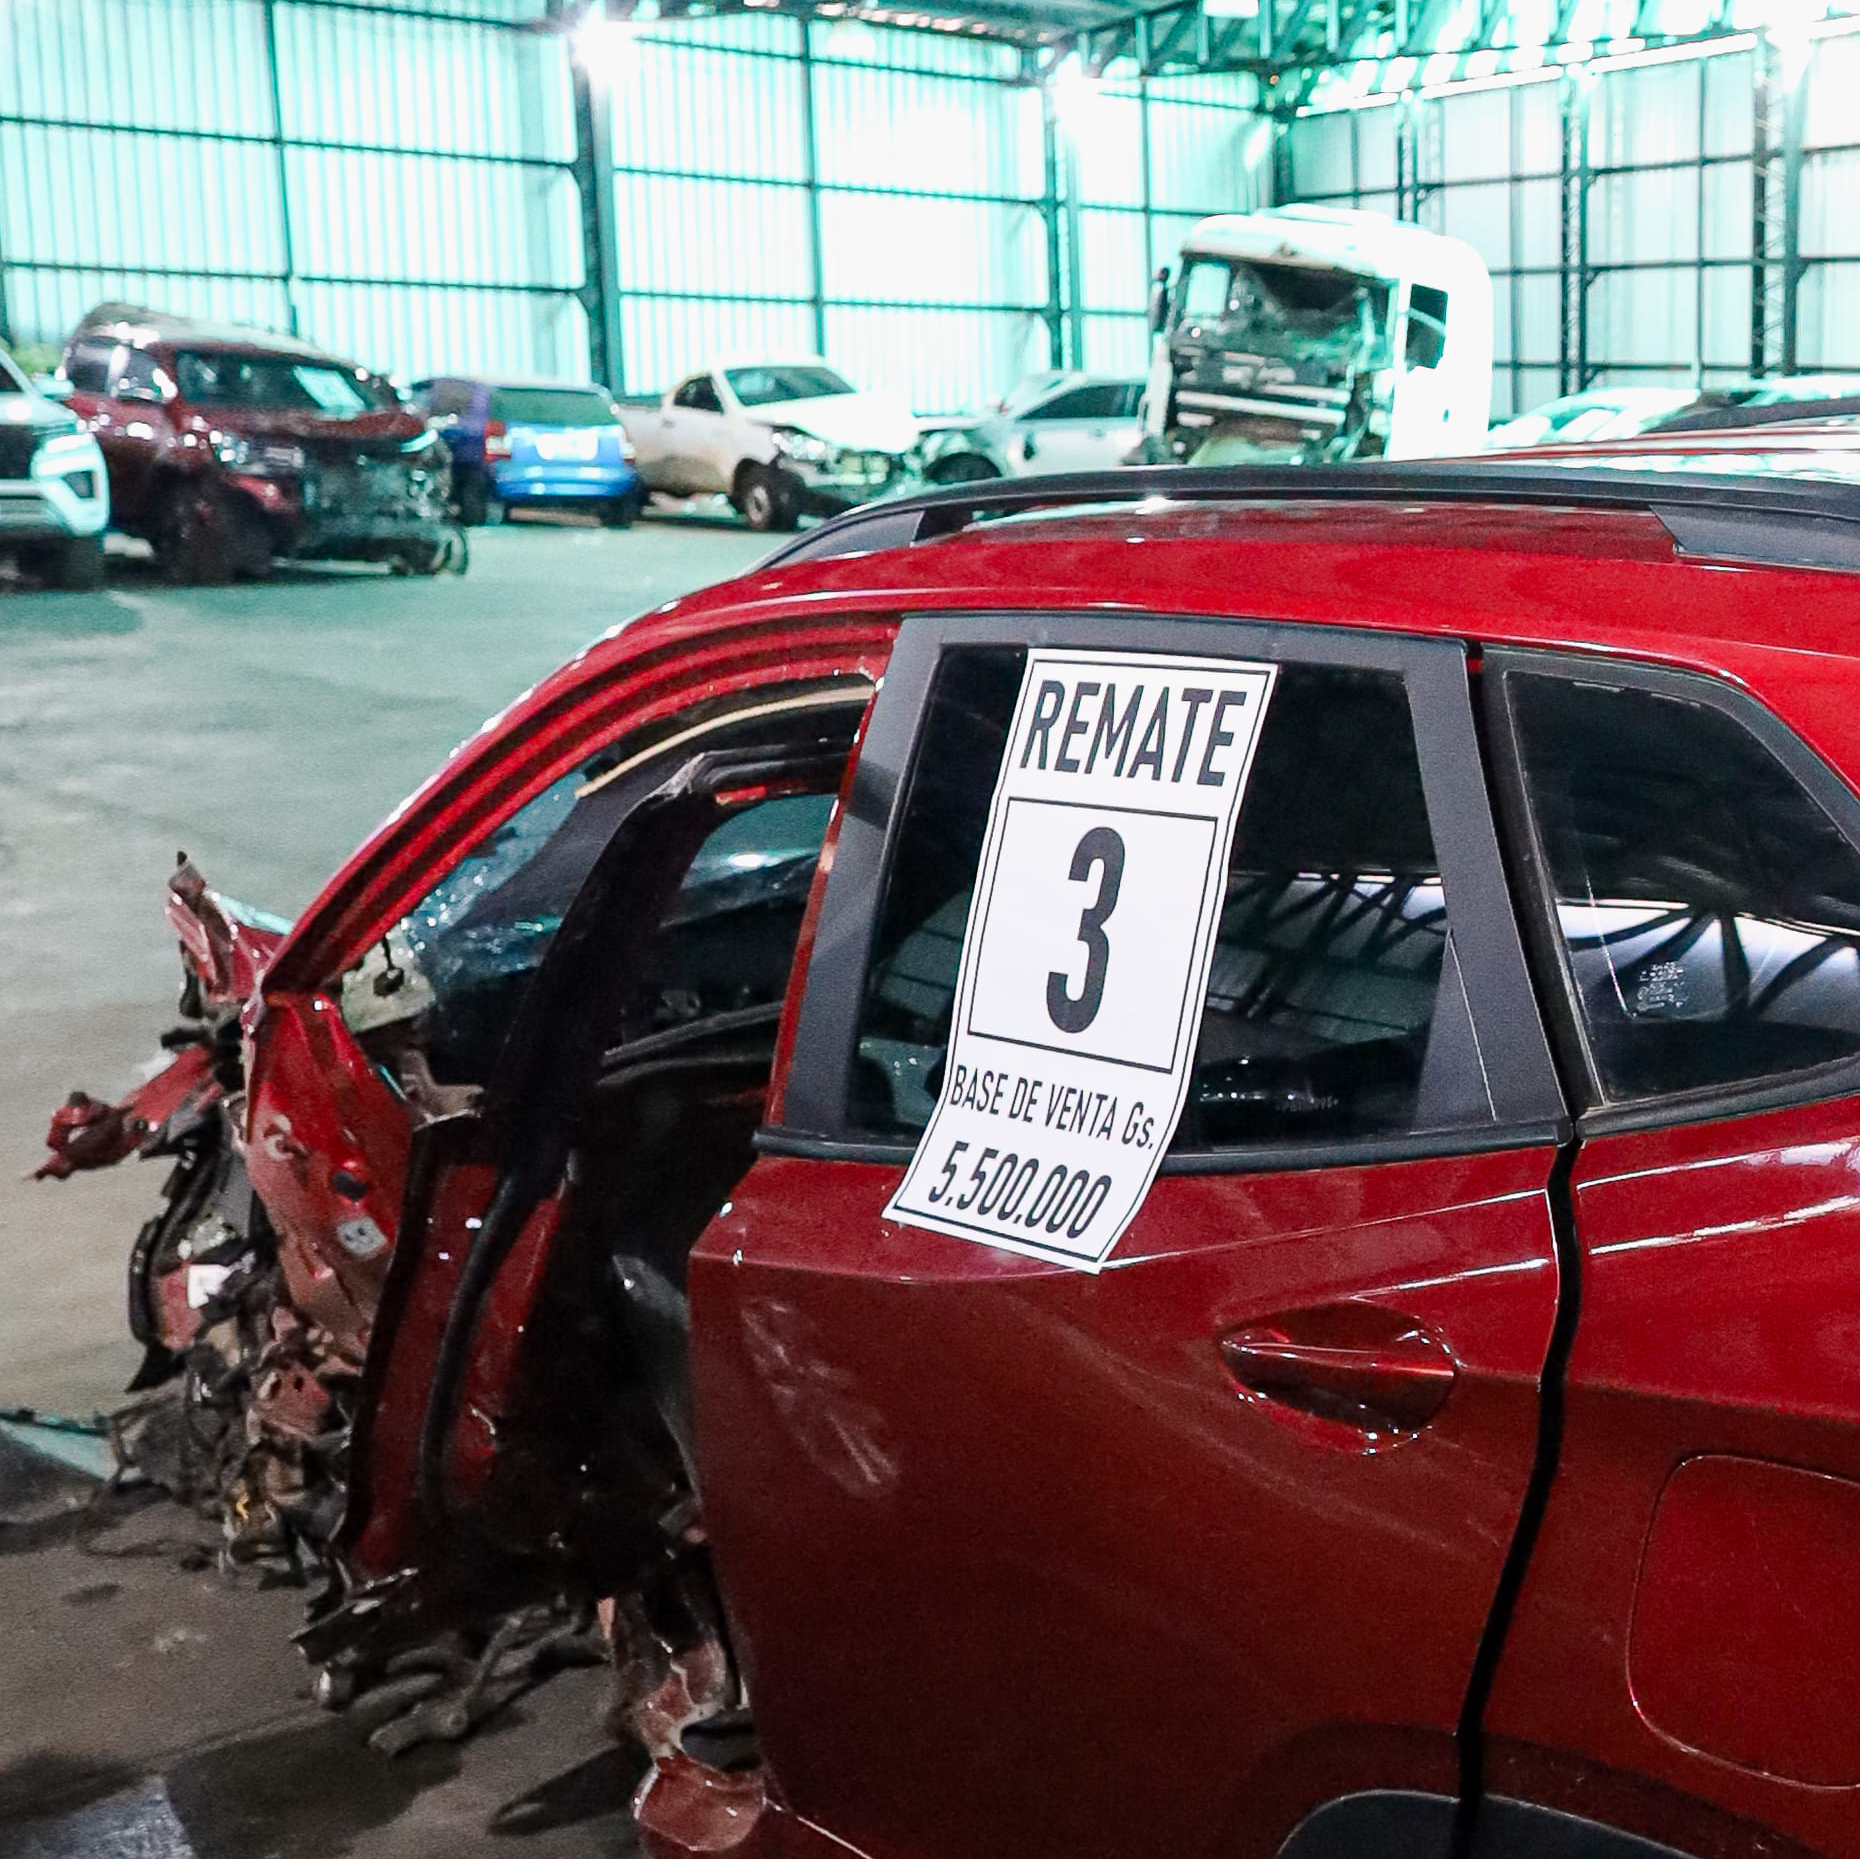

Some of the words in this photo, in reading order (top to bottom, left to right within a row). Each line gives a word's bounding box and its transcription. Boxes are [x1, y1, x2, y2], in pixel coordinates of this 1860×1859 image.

[1019, 680, 1248, 787] REMATE
[1046, 826, 1126, 1034] 3
[949, 1064, 1009, 1119] BASE
[1008, 1077, 1043, 1123] DE
[1044, 1083, 1118, 1141] VENTA
[1121, 1101, 1156, 1149] Gs.
[928, 1140, 1112, 1239] 5.500.000
